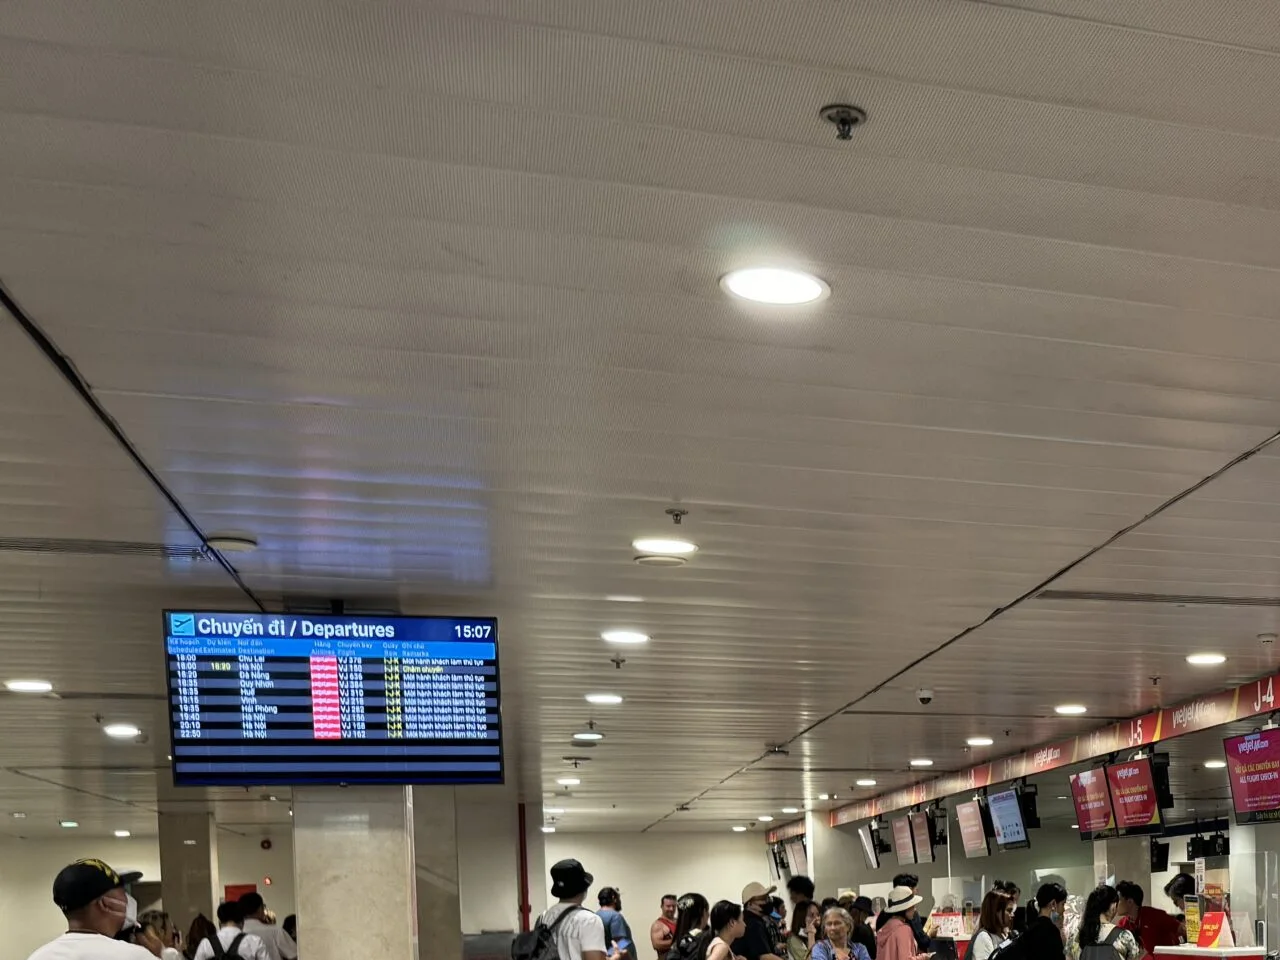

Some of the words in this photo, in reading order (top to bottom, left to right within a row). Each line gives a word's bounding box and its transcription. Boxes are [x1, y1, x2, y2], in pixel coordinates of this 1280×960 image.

[198, 618, 264, 637] Chuyến
[268, 619, 286, 636] đi
[290, 620, 297, 637] /
[301, 621, 395, 639] Departures
[454, 625, 492, 639] 15:07
[1253, 677, 1274, 713] J-4
[1128, 718, 1143, 747] J-5
